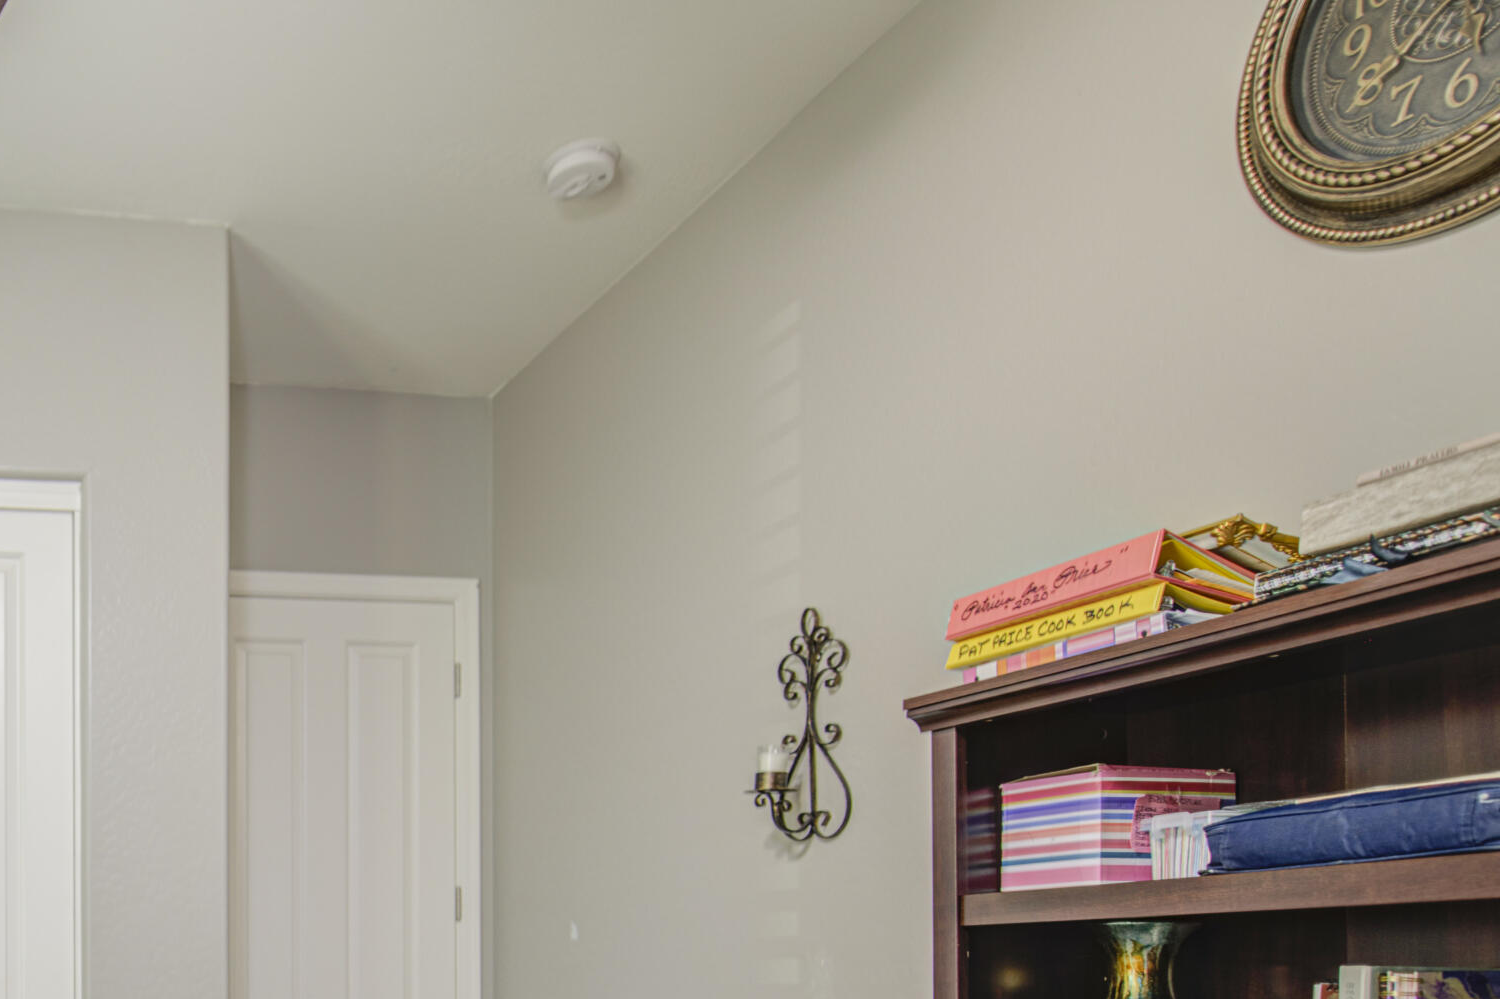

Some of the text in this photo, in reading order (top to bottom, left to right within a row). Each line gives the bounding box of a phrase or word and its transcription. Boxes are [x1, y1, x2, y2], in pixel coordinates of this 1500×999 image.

[1343, 24, 1373, 71] 9
[1390, 74, 1423, 127] 7
[1444, 57, 1480, 108] 6
[1038, 614, 1076, 638] COOK
